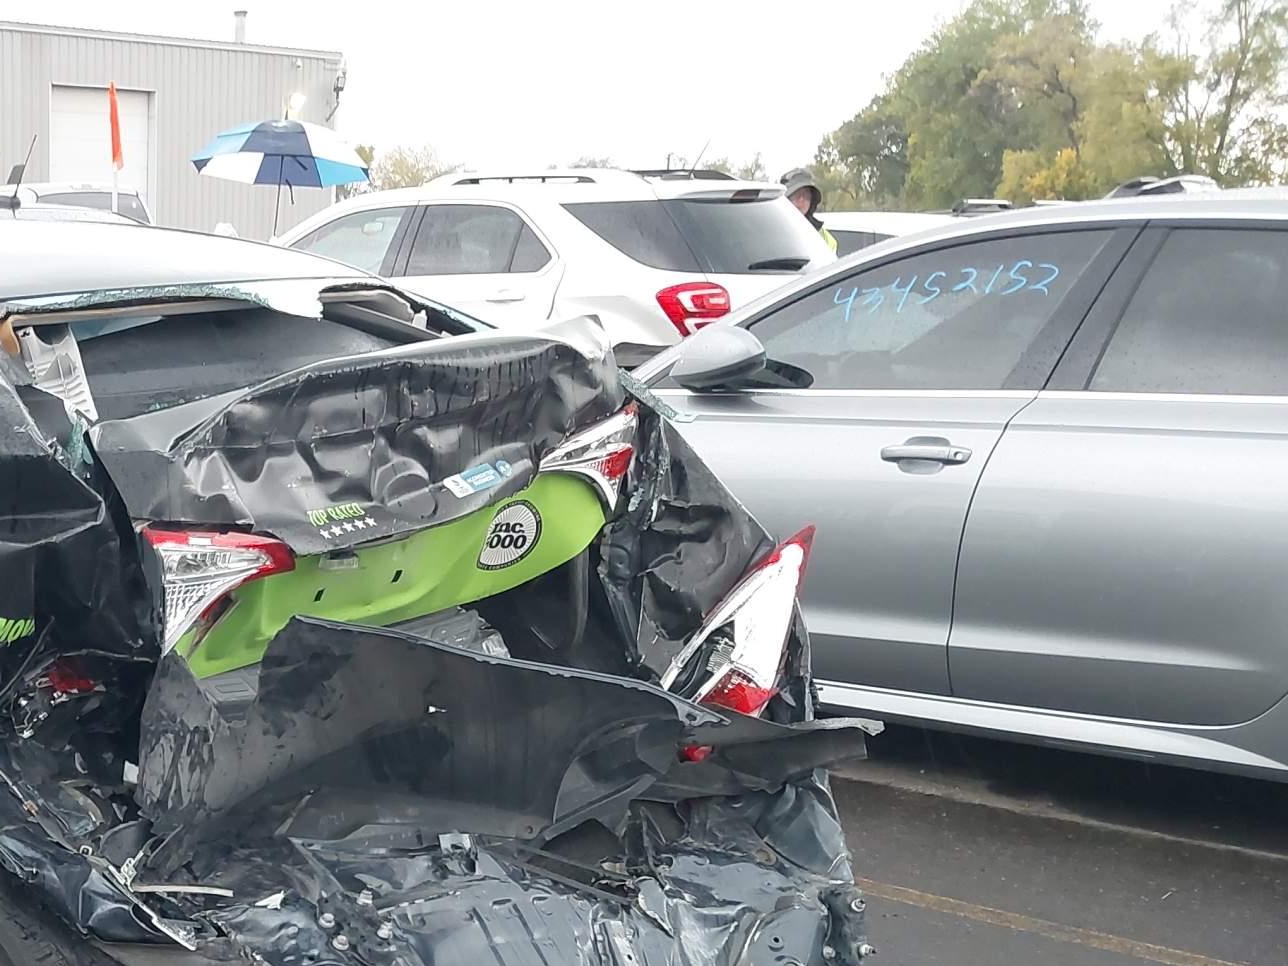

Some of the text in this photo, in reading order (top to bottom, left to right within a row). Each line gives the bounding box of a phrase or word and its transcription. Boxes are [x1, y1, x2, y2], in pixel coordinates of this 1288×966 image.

[833, 260, 1060, 321] 43452152
[306, 502, 366, 527] TOP RATED
